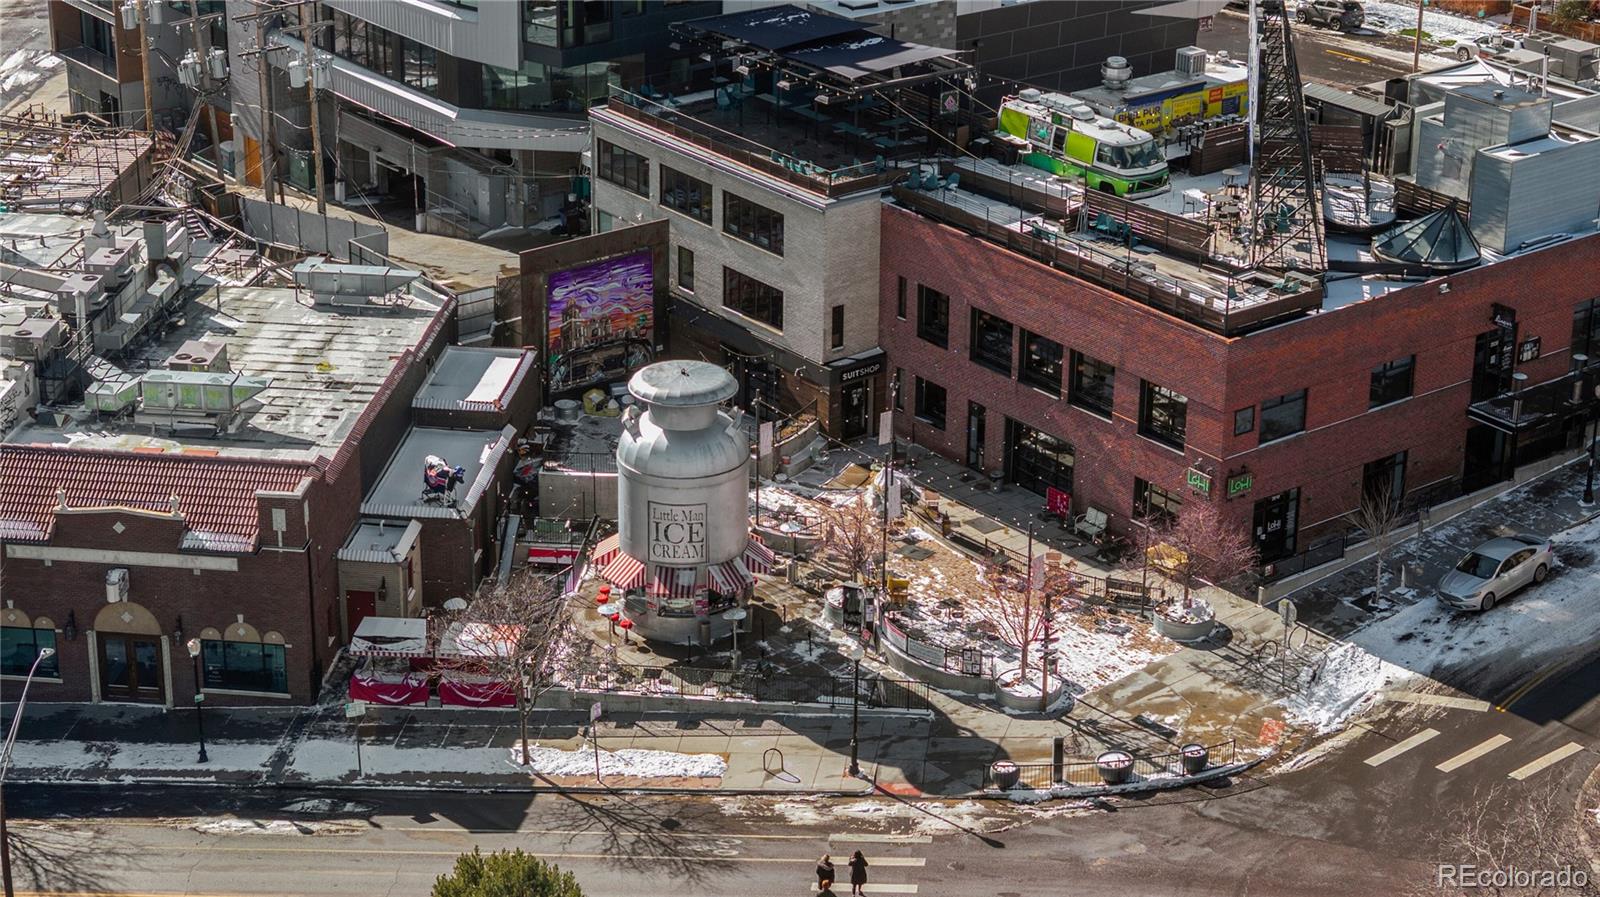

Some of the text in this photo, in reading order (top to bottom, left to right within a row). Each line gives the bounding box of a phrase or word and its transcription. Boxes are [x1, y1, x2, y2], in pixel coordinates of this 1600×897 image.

[842, 363, 880, 381] SUITSHOP
[652, 507, 704, 522] Little Man
[652, 520, 705, 544] ICE
[652, 543, 704, 559] CREAM
